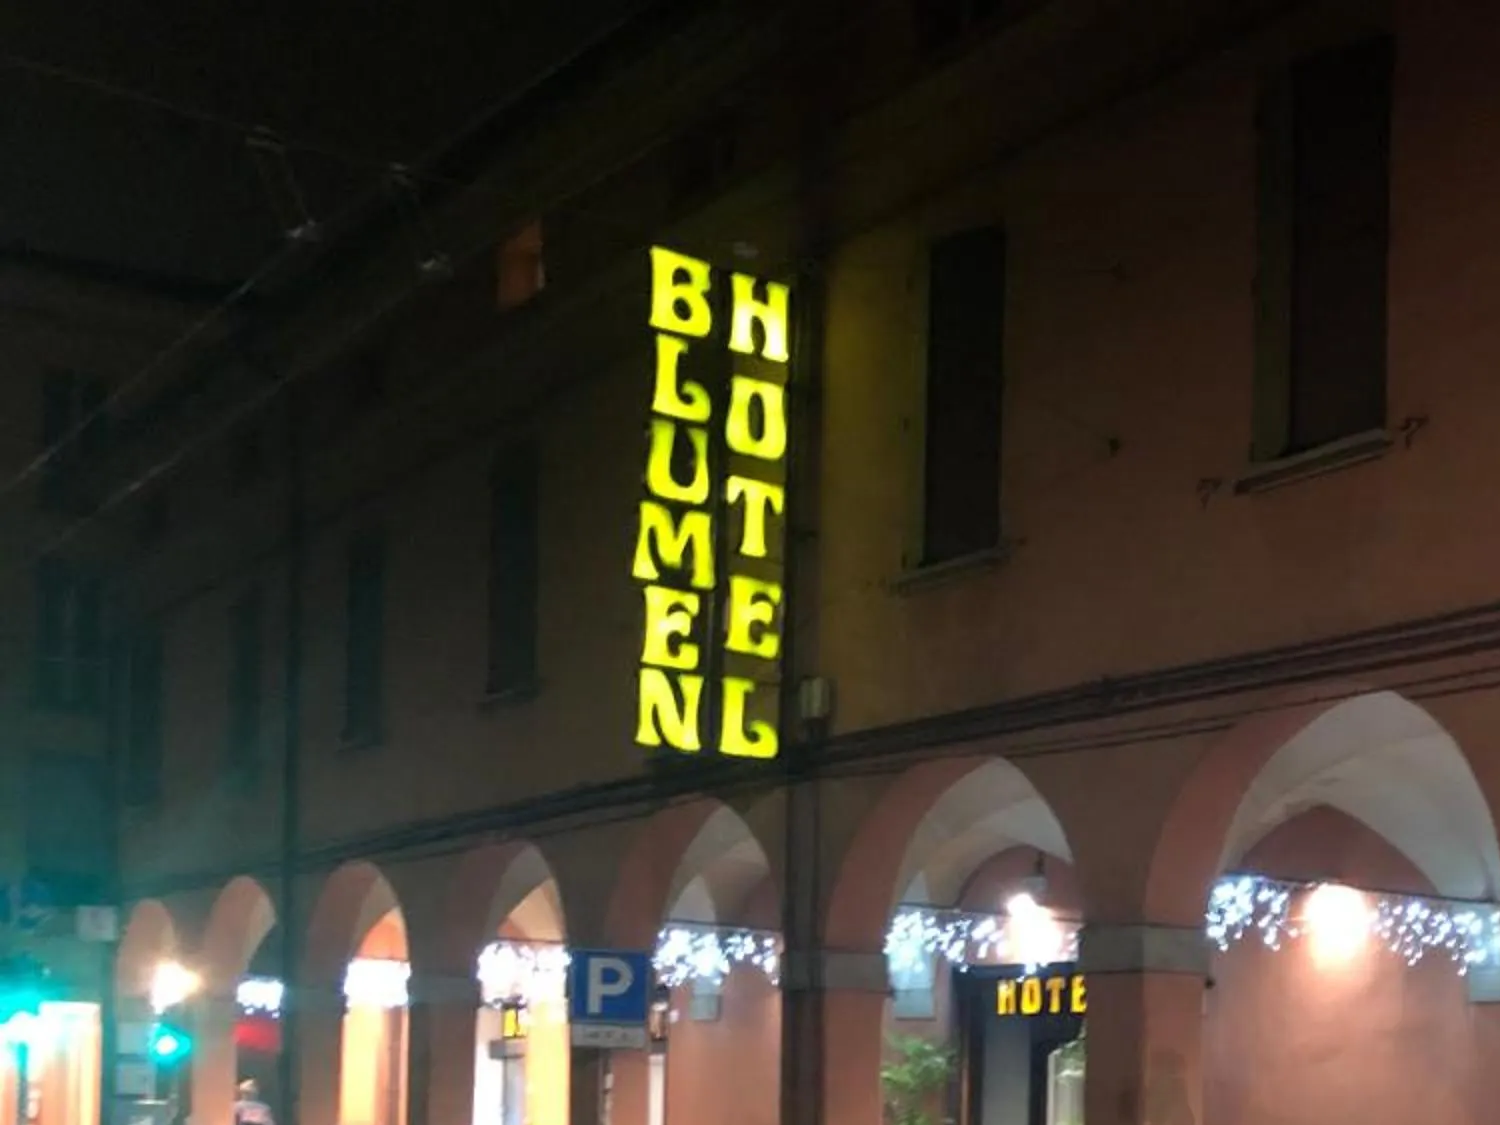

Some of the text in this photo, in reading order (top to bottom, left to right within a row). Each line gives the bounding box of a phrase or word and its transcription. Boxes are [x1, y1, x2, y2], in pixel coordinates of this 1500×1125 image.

[632, 246, 715, 752] BLUMEN
[719, 273, 790, 758] HOTEL
[587, 957, 635, 1014] P
